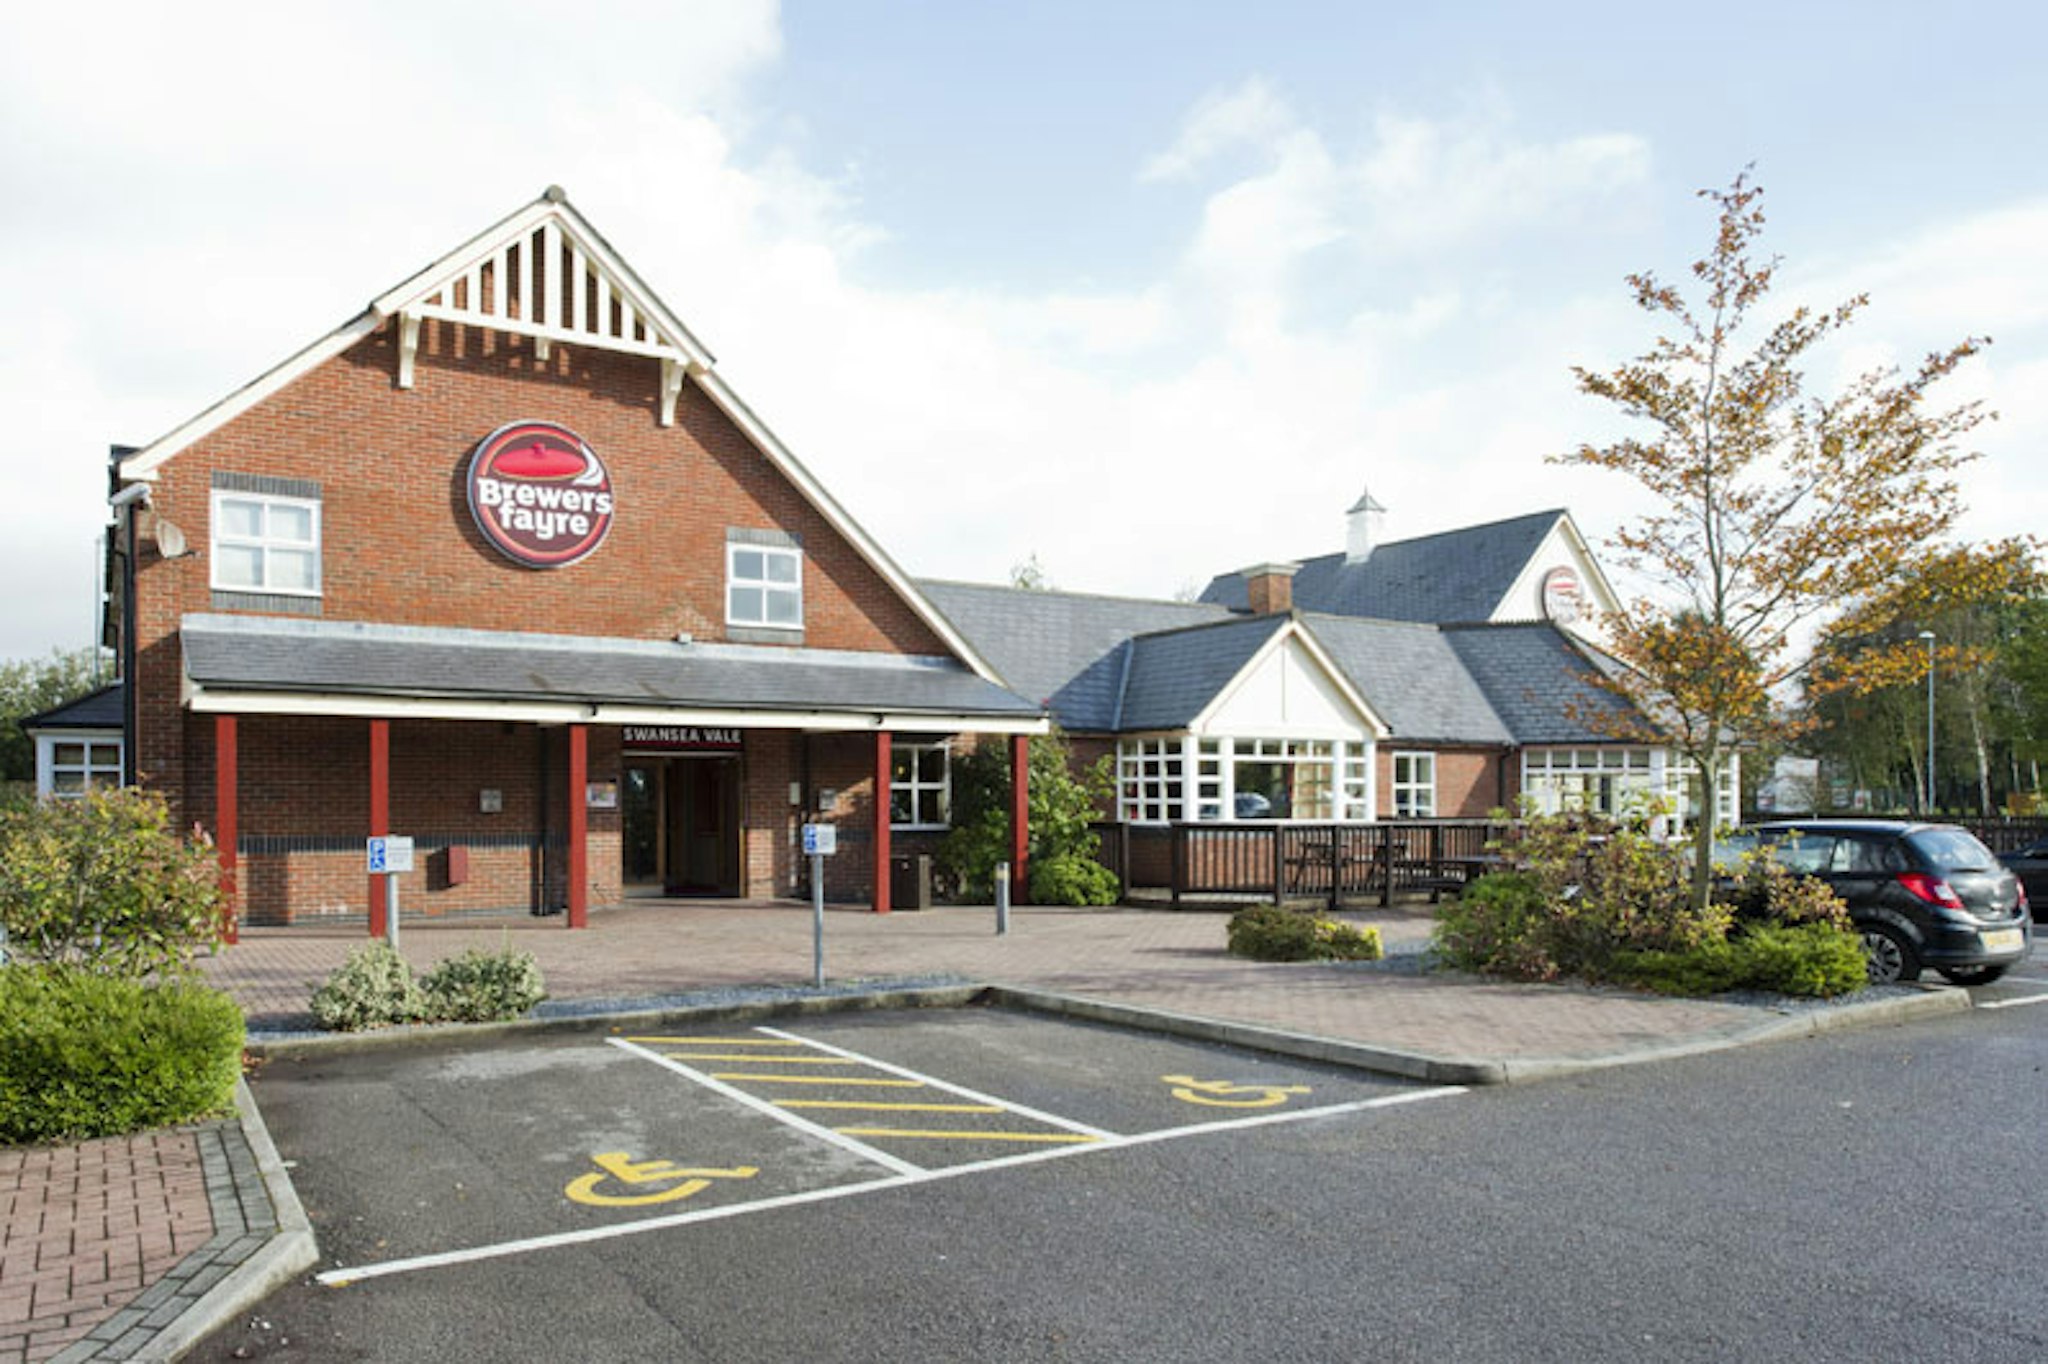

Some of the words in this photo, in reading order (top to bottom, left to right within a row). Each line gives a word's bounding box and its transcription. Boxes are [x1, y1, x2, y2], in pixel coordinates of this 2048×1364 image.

[477, 477, 612, 514] Brewers
[499, 500, 589, 539] fayre
[623, 727, 700, 742] SWANSEA
[703, 729, 741, 743] VALE
